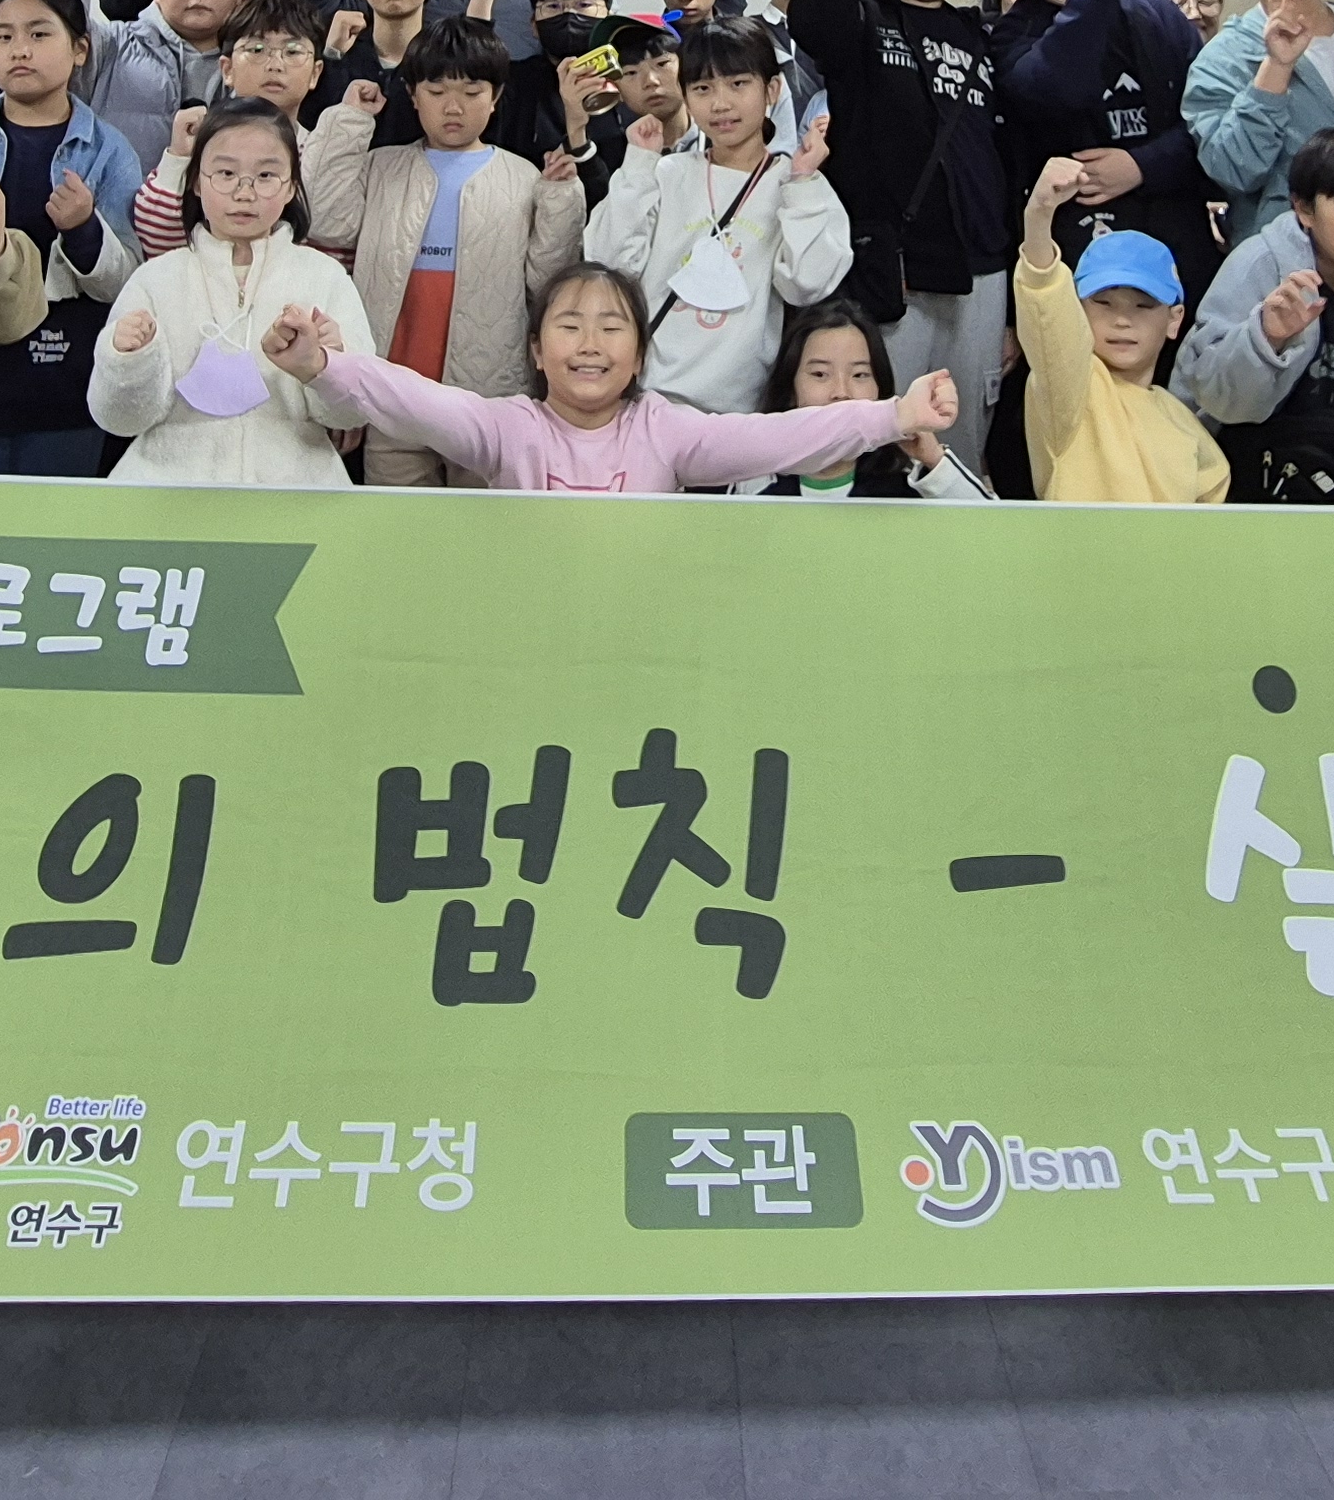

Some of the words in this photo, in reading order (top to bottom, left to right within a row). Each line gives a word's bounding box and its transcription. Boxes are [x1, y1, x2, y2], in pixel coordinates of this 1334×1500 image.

[420, 244, 453, 257] ROBOT
[373, 727, 789, 1006] 법칙
[47, 1097, 109, 1117] Better
[113, 1097, 144, 1117] life
[176, 1118, 478, 1211] 연수구청
[665, 1125, 816, 1216] 주관
[10, 1203, 119, 1244] 연수구
